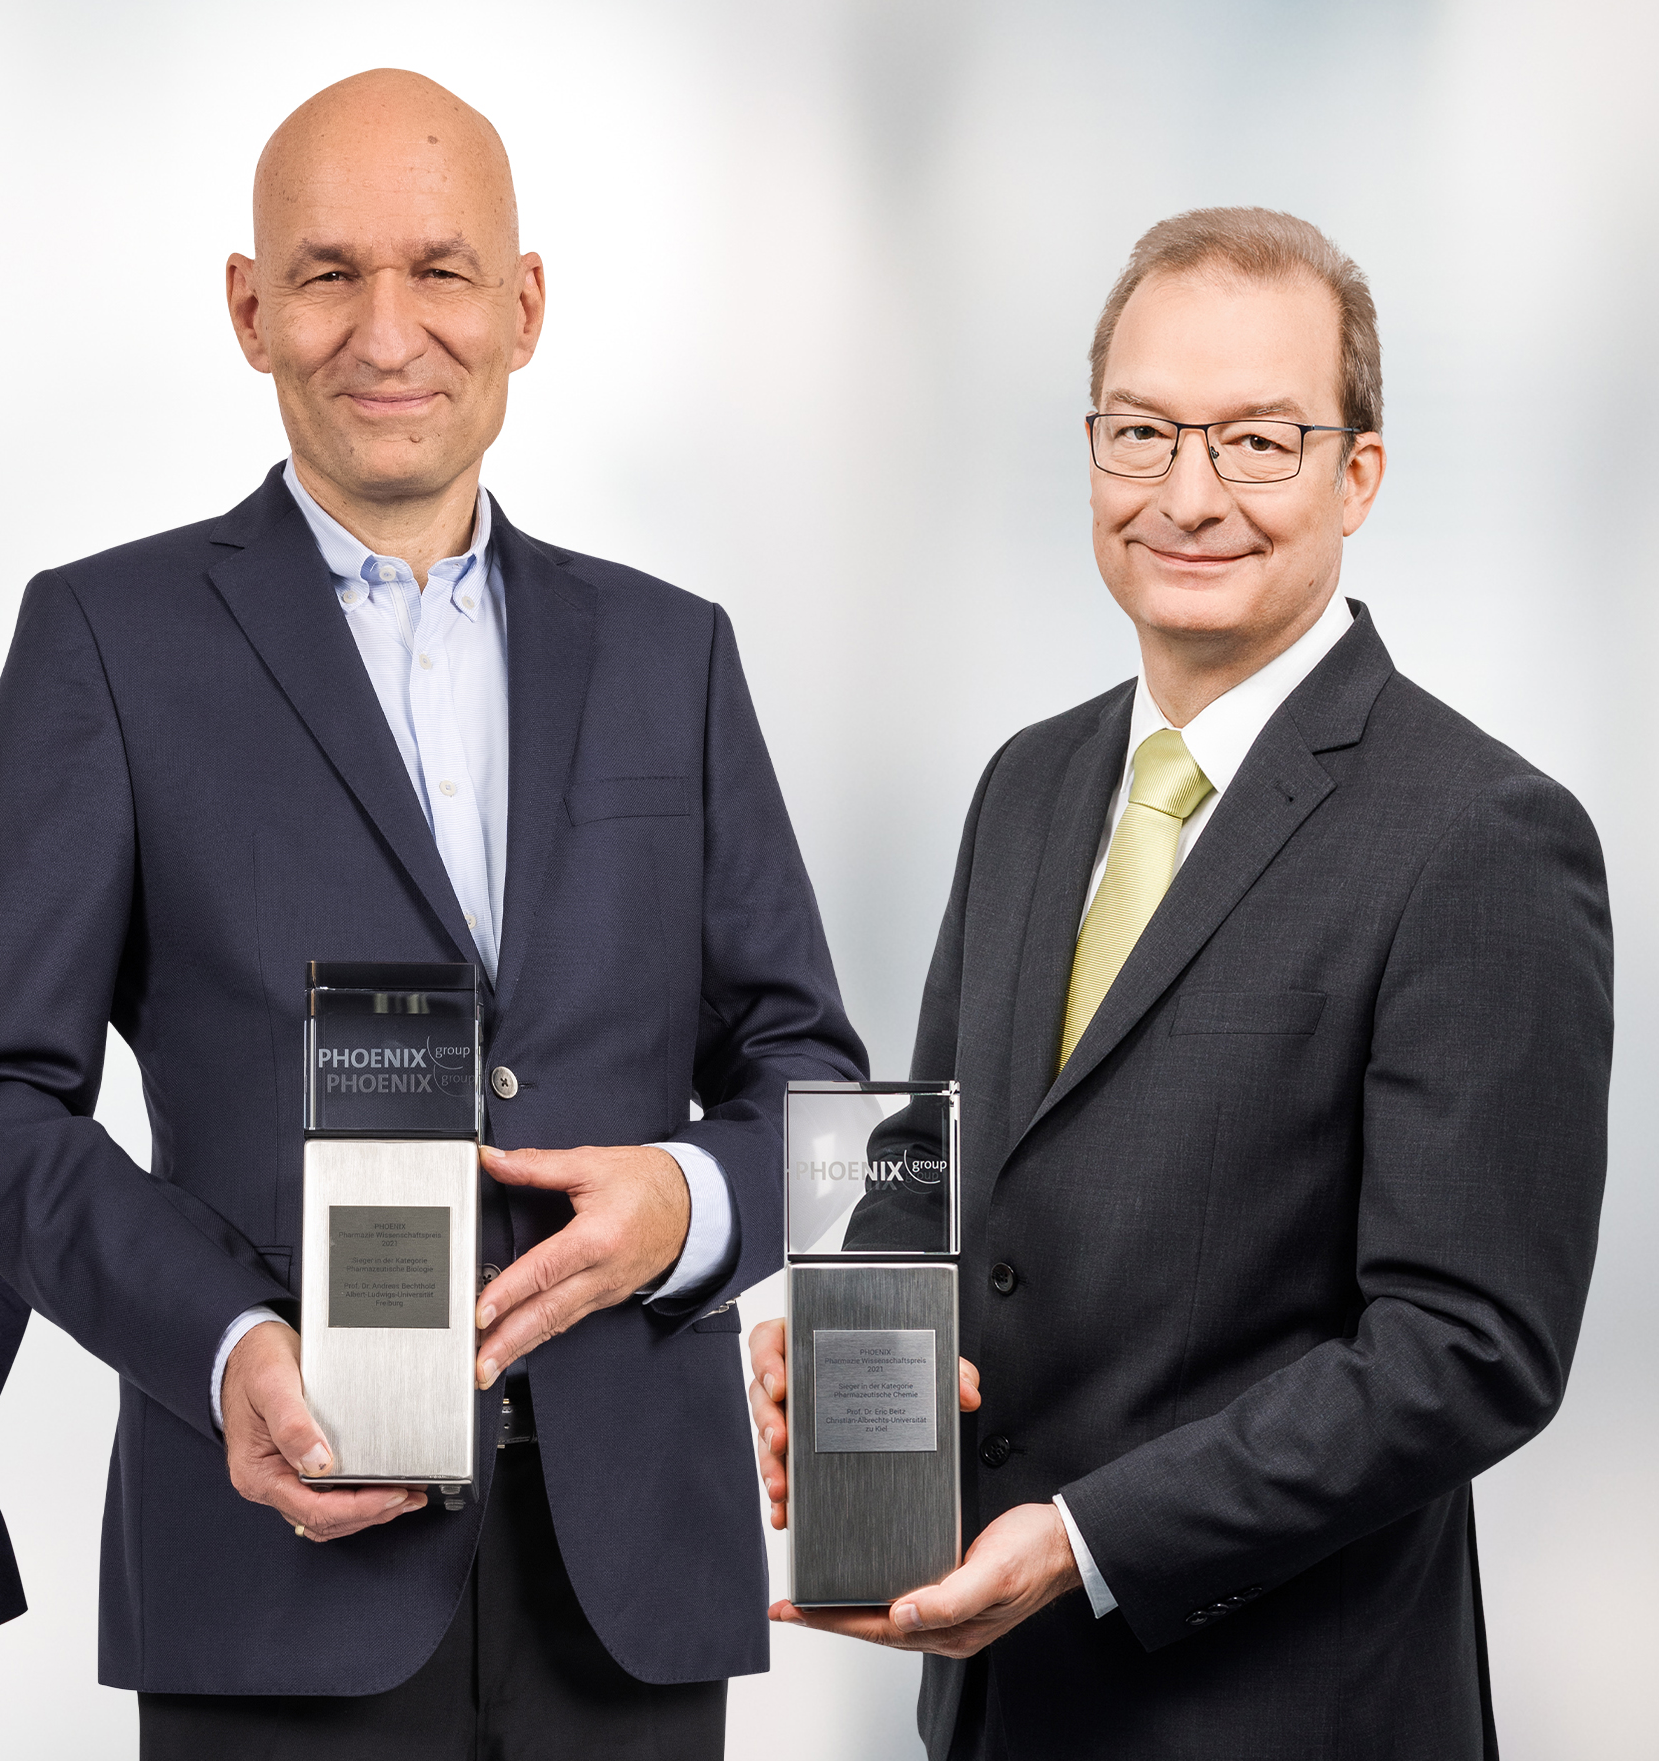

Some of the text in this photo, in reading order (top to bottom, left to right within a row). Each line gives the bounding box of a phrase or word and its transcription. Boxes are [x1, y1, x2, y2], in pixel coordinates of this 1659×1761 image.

[319, 1046, 470, 1068] PHOENIX group
[327, 1073, 433, 1093] PHOENIX
[796, 1159, 947, 1182] PHOENIX group
[352, 1257, 374, 1265] Sieger
[862, 1357, 927, 1365] Wissenschaftspreis
[839, 1383, 860, 1391] Sieger
[882, 1383, 913, 1391] Kategorie
